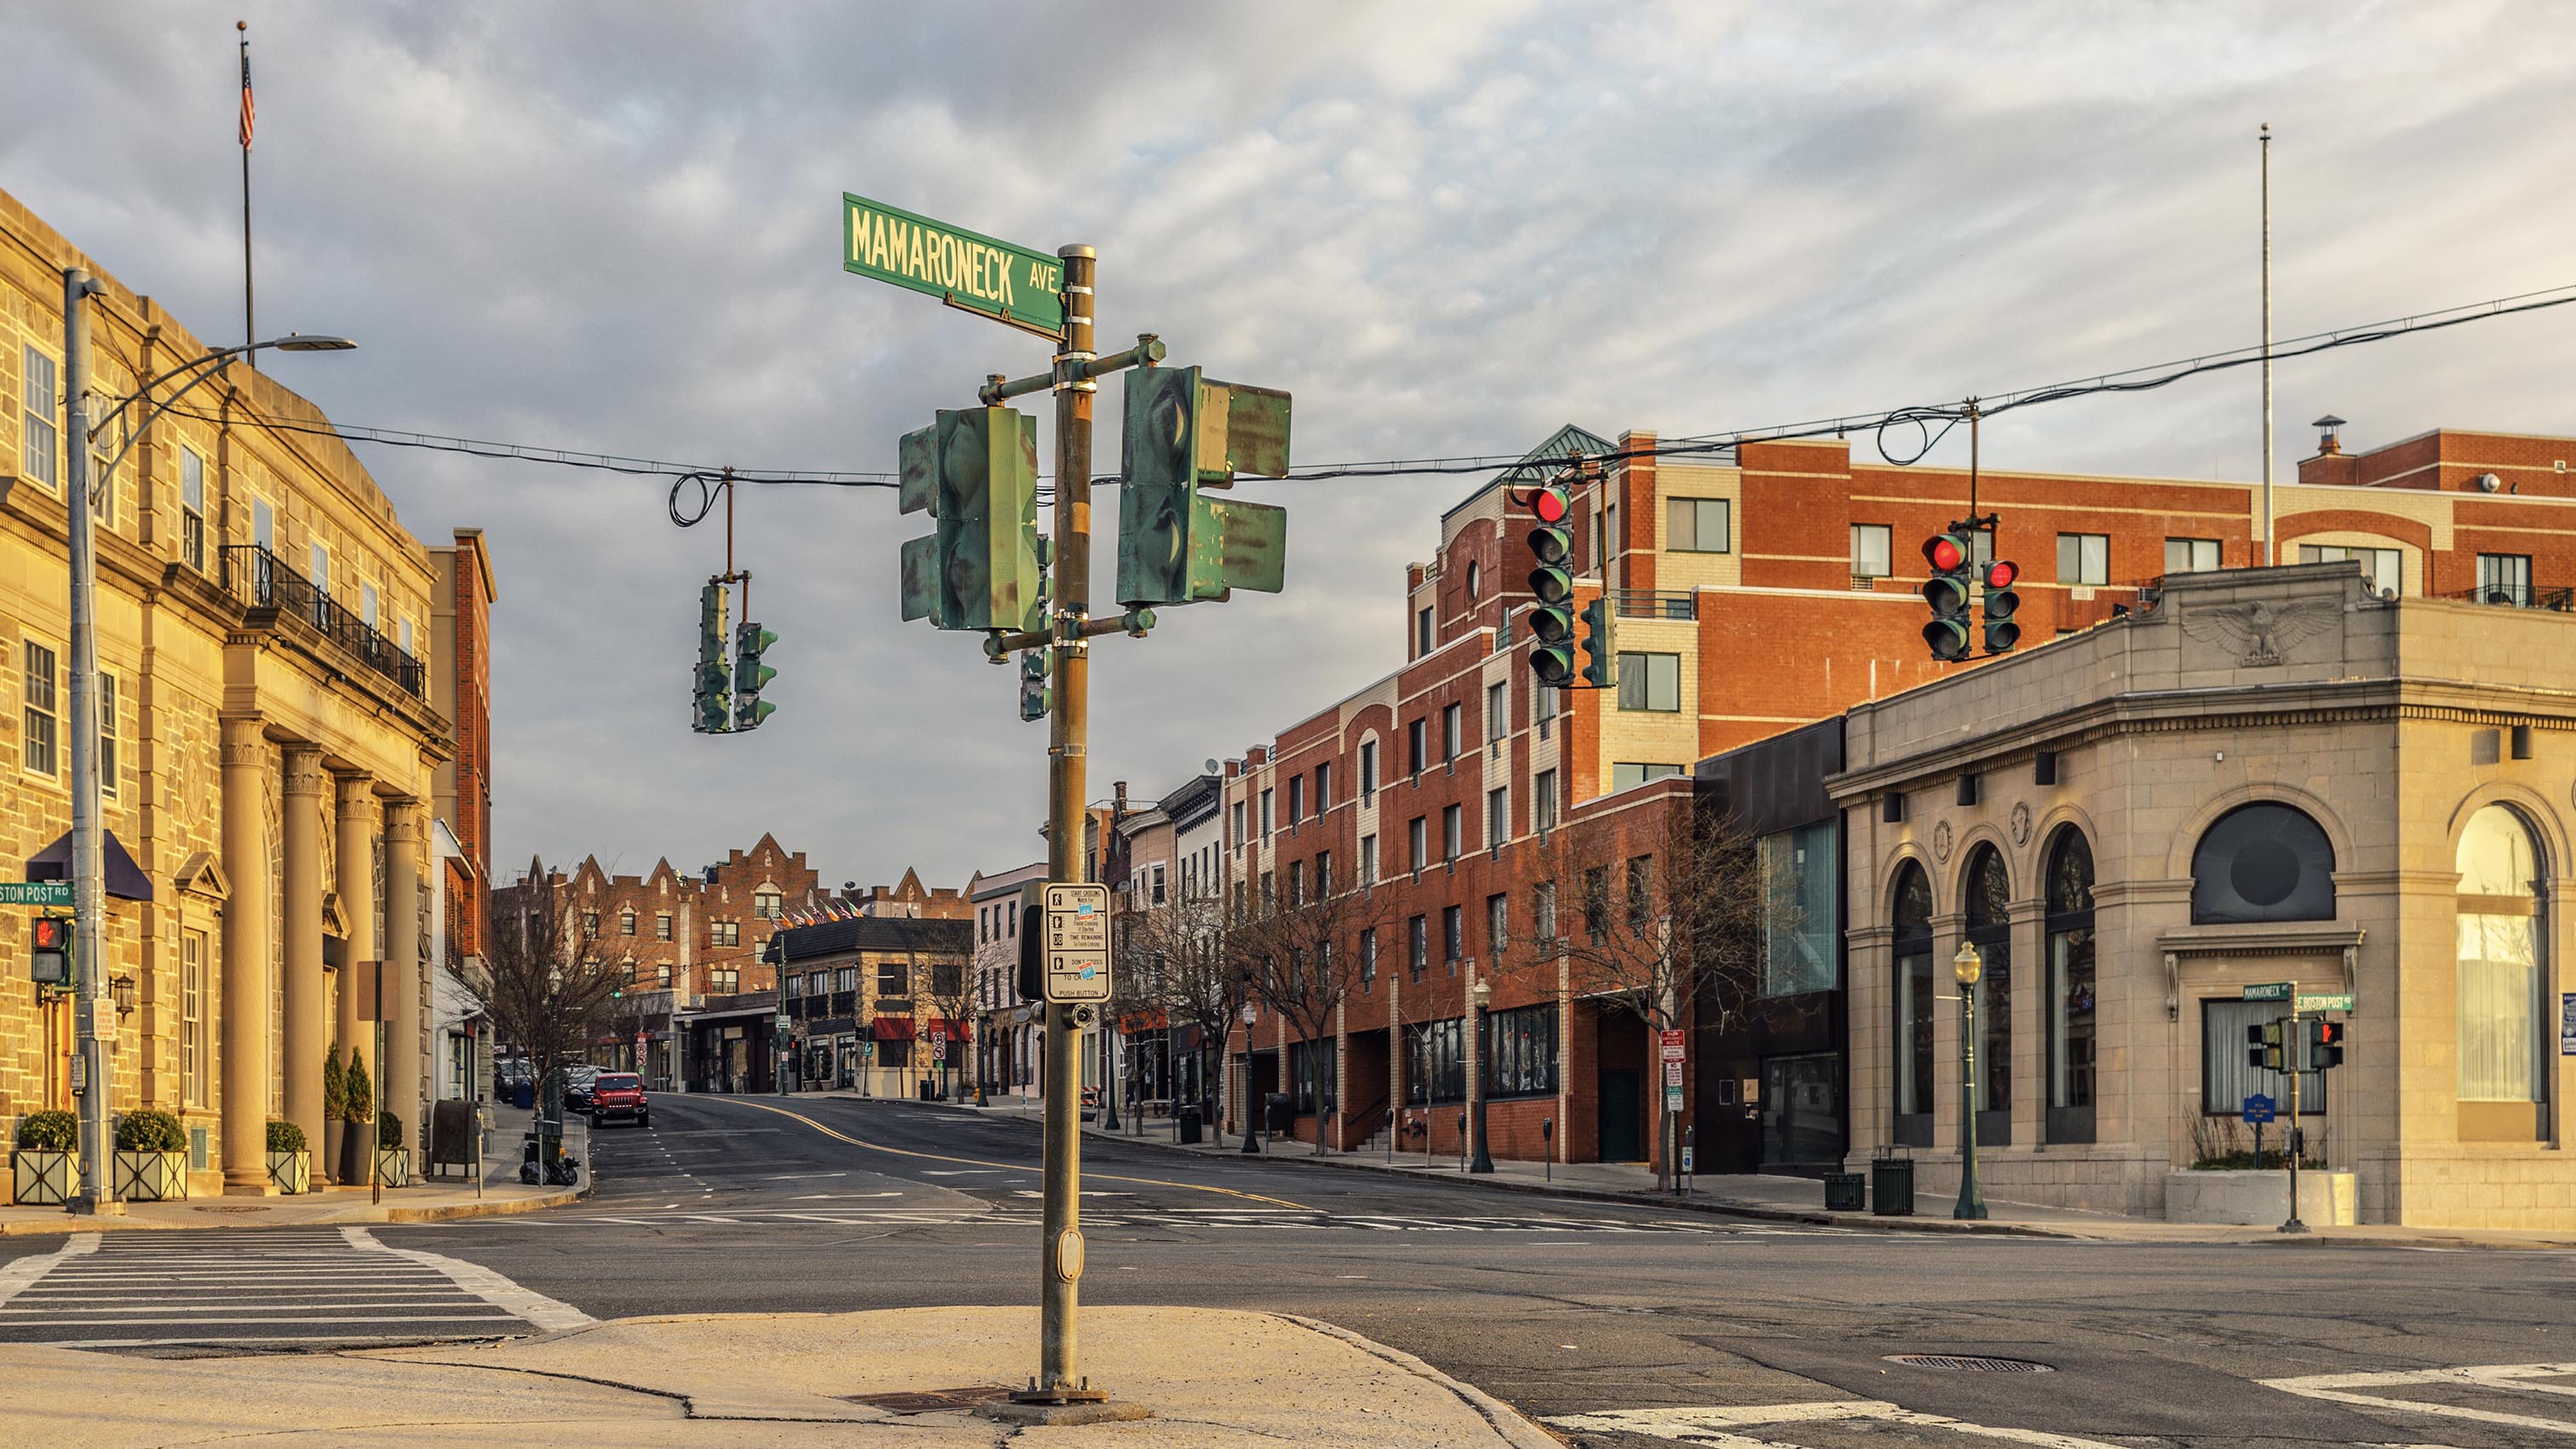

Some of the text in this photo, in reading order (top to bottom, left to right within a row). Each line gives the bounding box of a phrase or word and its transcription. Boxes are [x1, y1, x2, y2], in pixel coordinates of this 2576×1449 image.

[851, 206, 1014, 307] MAMARONECK
[26, 886, 53, 901] POST
[55, 887, 69, 896] RD
[1054, 934, 1063, 944] 08
[2303, 997, 2327, 1009] BOSTON
[2327, 997, 2343, 1009] POST
